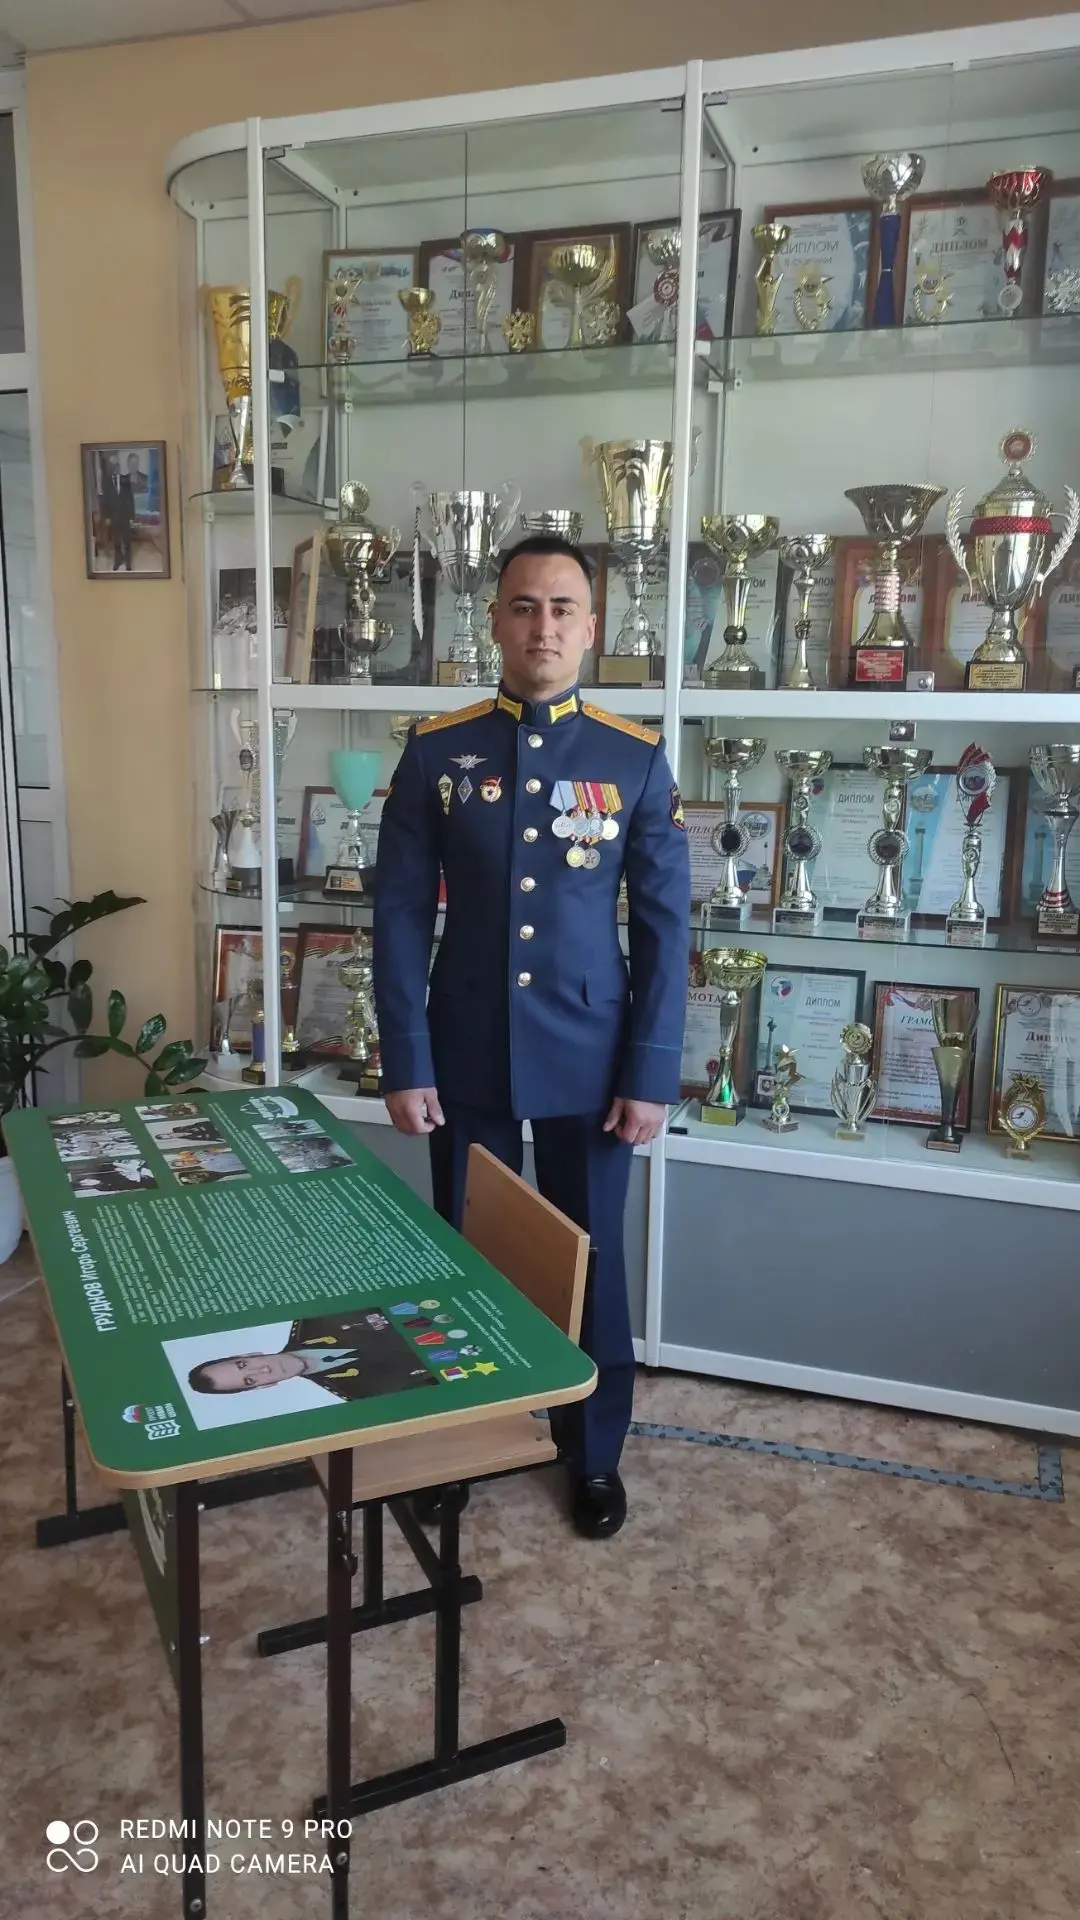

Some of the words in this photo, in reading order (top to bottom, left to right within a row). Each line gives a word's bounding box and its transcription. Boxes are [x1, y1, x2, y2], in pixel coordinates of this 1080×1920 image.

[838, 793, 875, 803] ДИПЛОМ
[805, 997, 841, 1008] ДИПЛОМ
[61, 1210, 89, 1253] Сергеевич
[77, 1253, 99, 1281] Игорь
[83, 1282, 117, 1332] ГРУДНОВ
